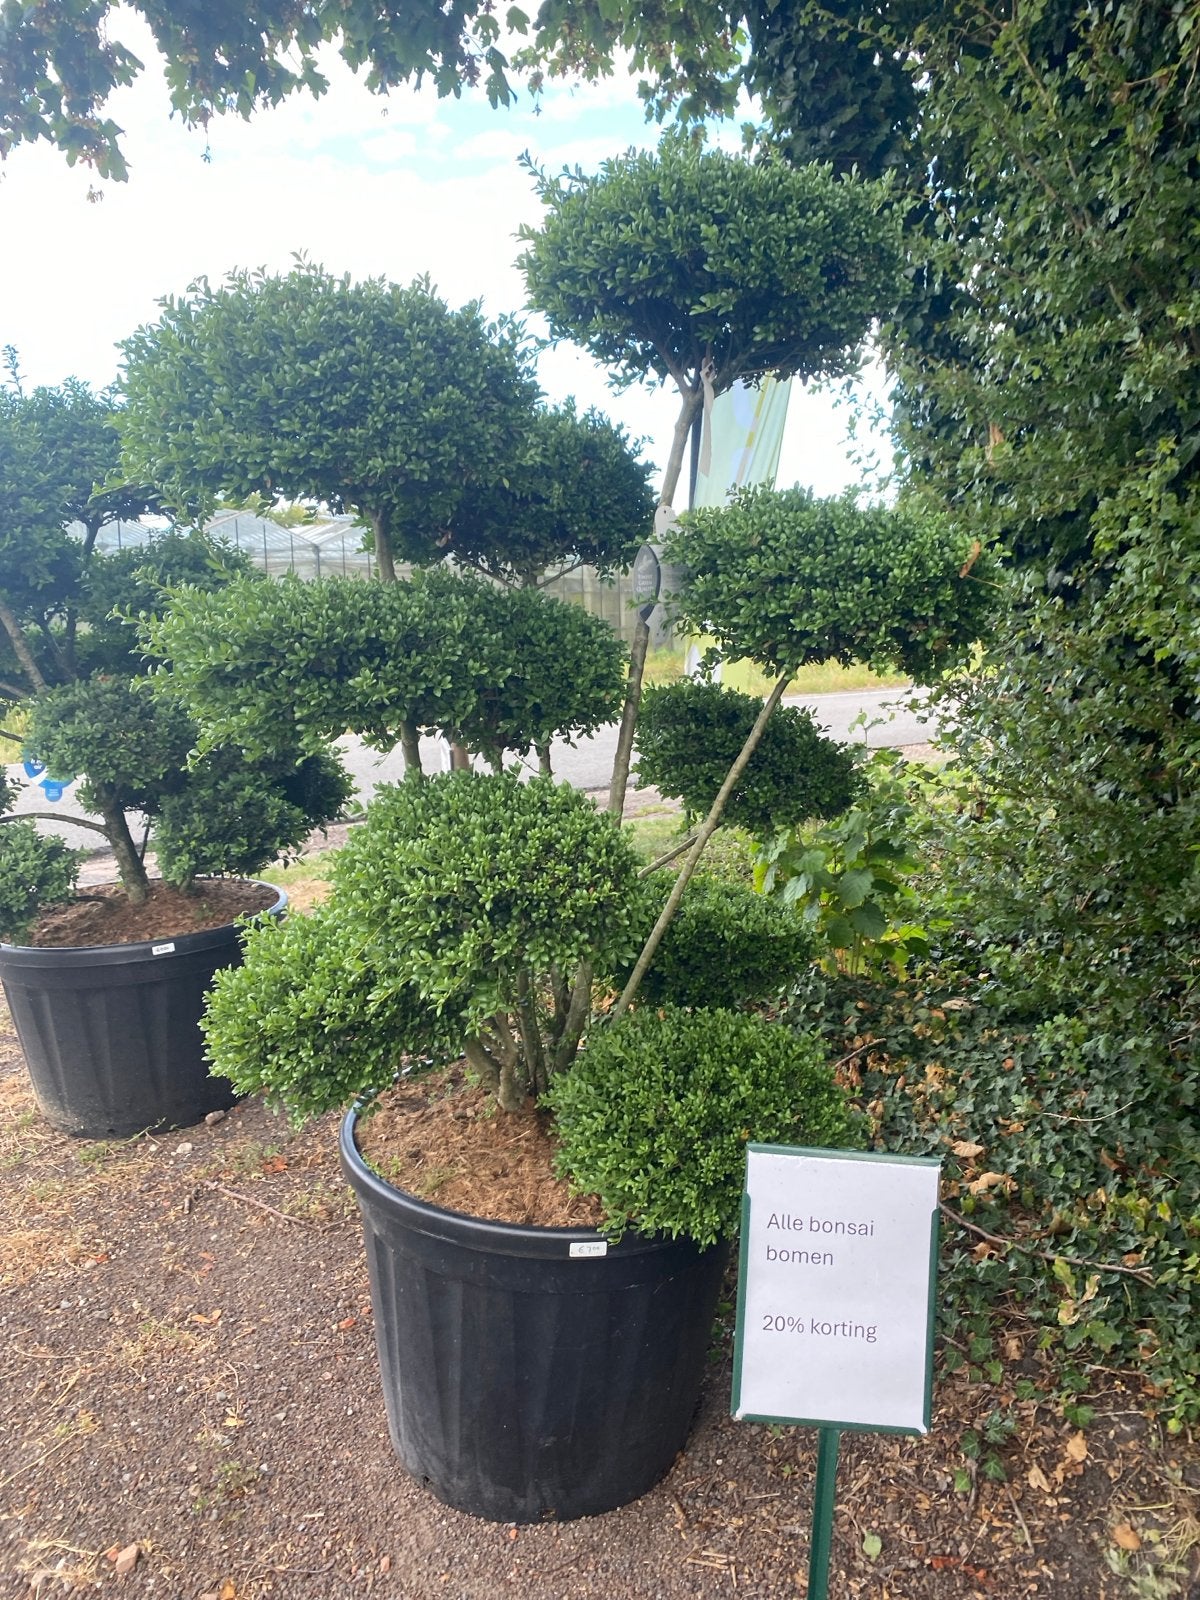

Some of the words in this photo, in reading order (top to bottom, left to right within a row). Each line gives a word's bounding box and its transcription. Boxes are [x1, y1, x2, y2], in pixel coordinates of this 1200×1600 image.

[767, 1213, 803, 1231] Alle
[809, 1216, 874, 1236] bonsai
[766, 1245, 834, 1265] bomen
[762, 1315, 805, 1334] 20%
[810, 1318, 878, 1343] korting
